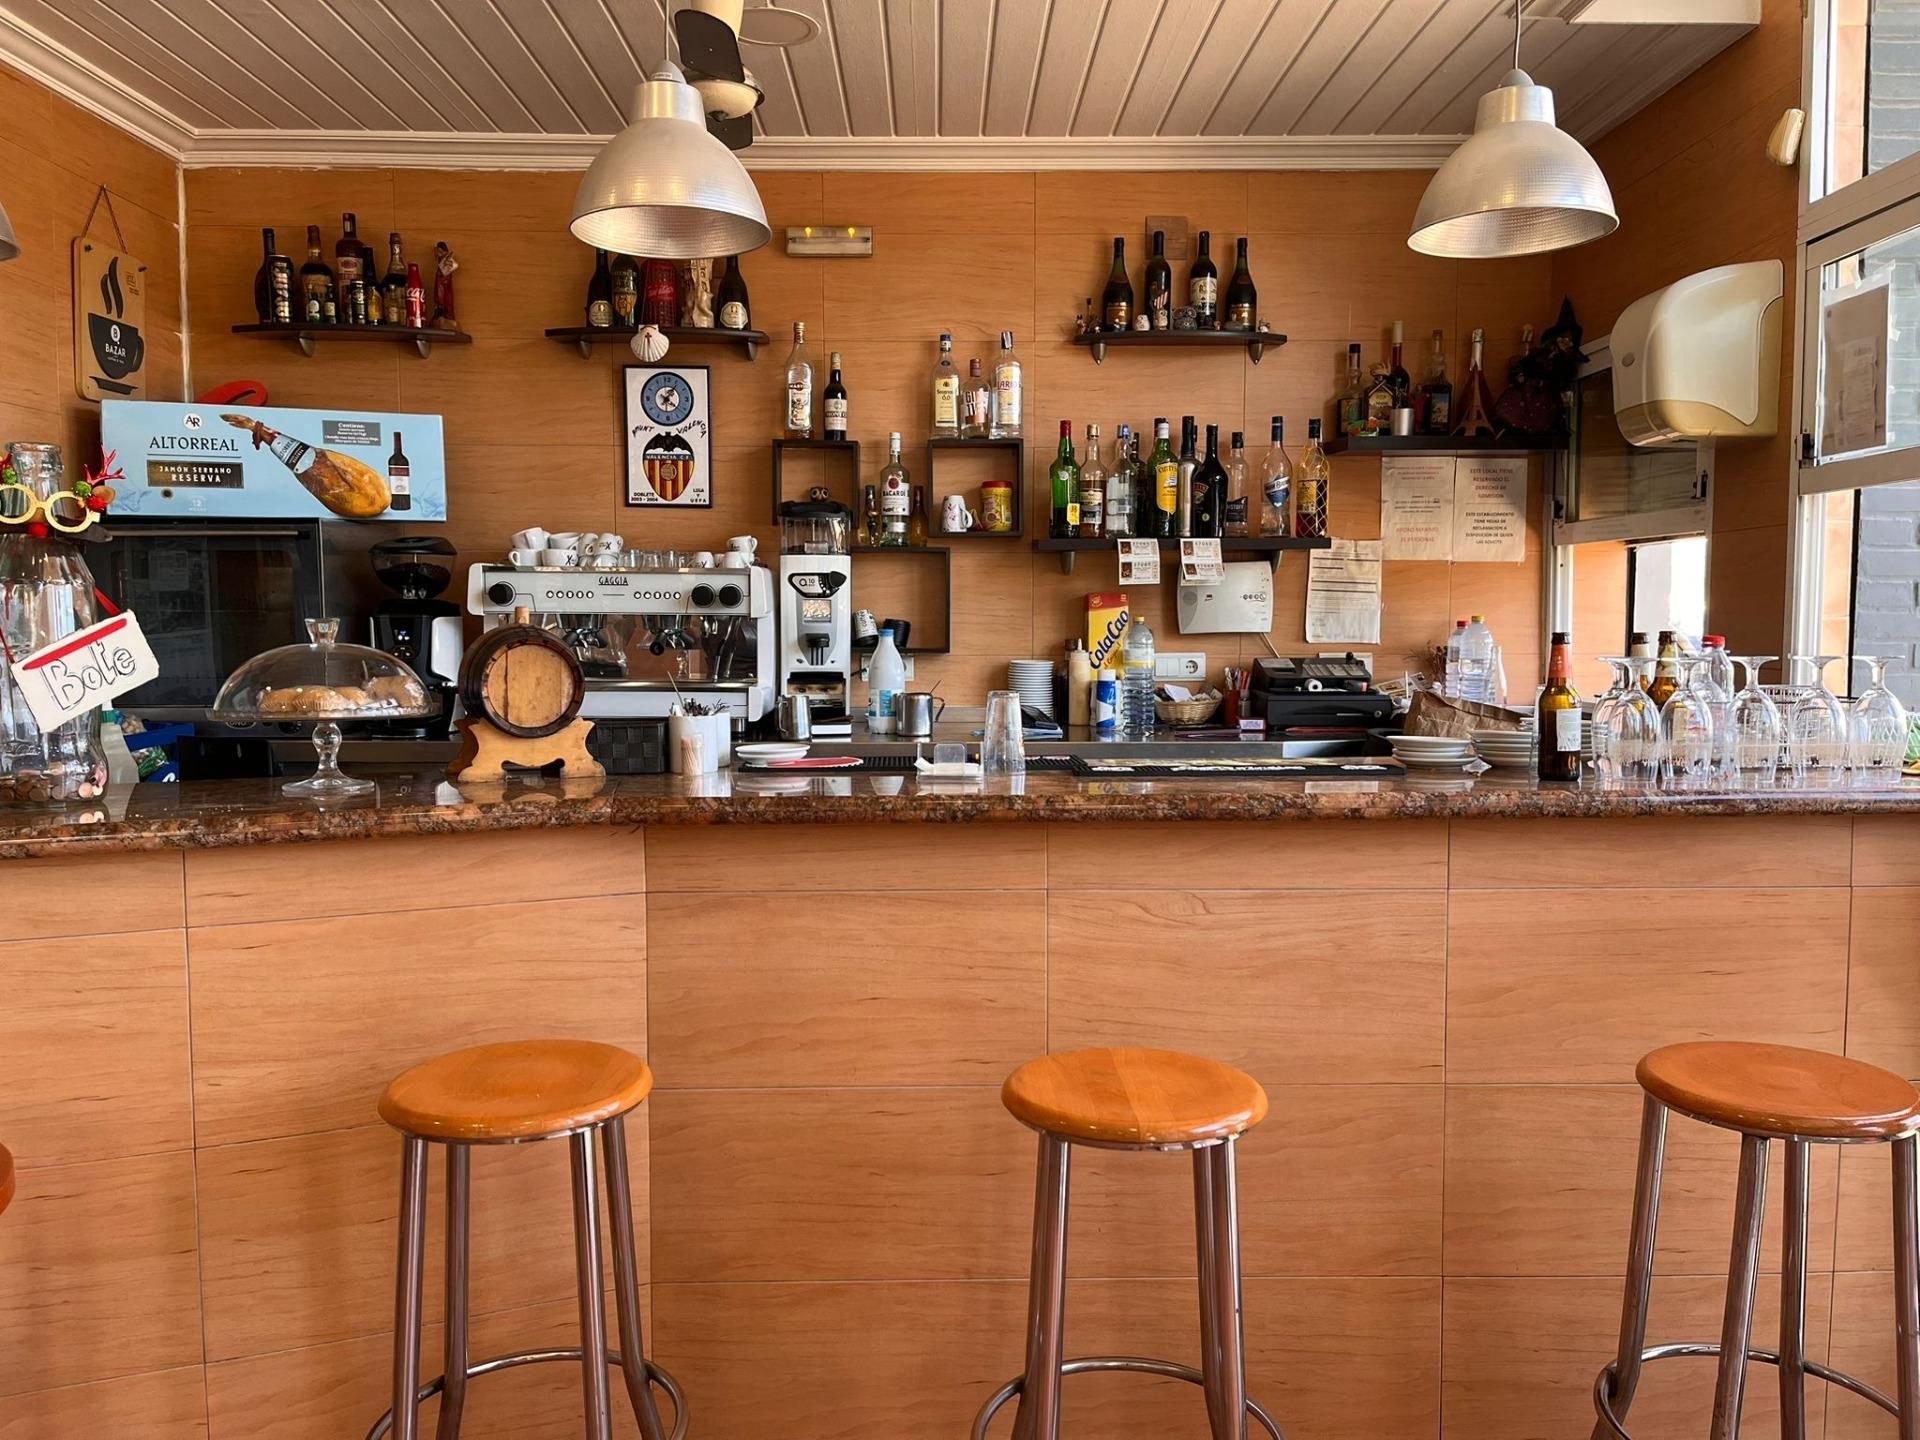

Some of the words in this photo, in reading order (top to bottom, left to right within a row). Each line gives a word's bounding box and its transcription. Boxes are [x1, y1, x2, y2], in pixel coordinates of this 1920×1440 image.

[105, 343, 127, 357] BAZAR
[149, 435, 239, 452] ALTORREAL
[159, 464, 189, 473] JAMÓN
[192, 466, 232, 474] SERRANO
[171, 473, 221, 483] RESERVA
[598, 576, 629, 586] GAGGIA
[1089, 609, 1129, 670] ColaCao
[40, 640, 136, 712] Bote
